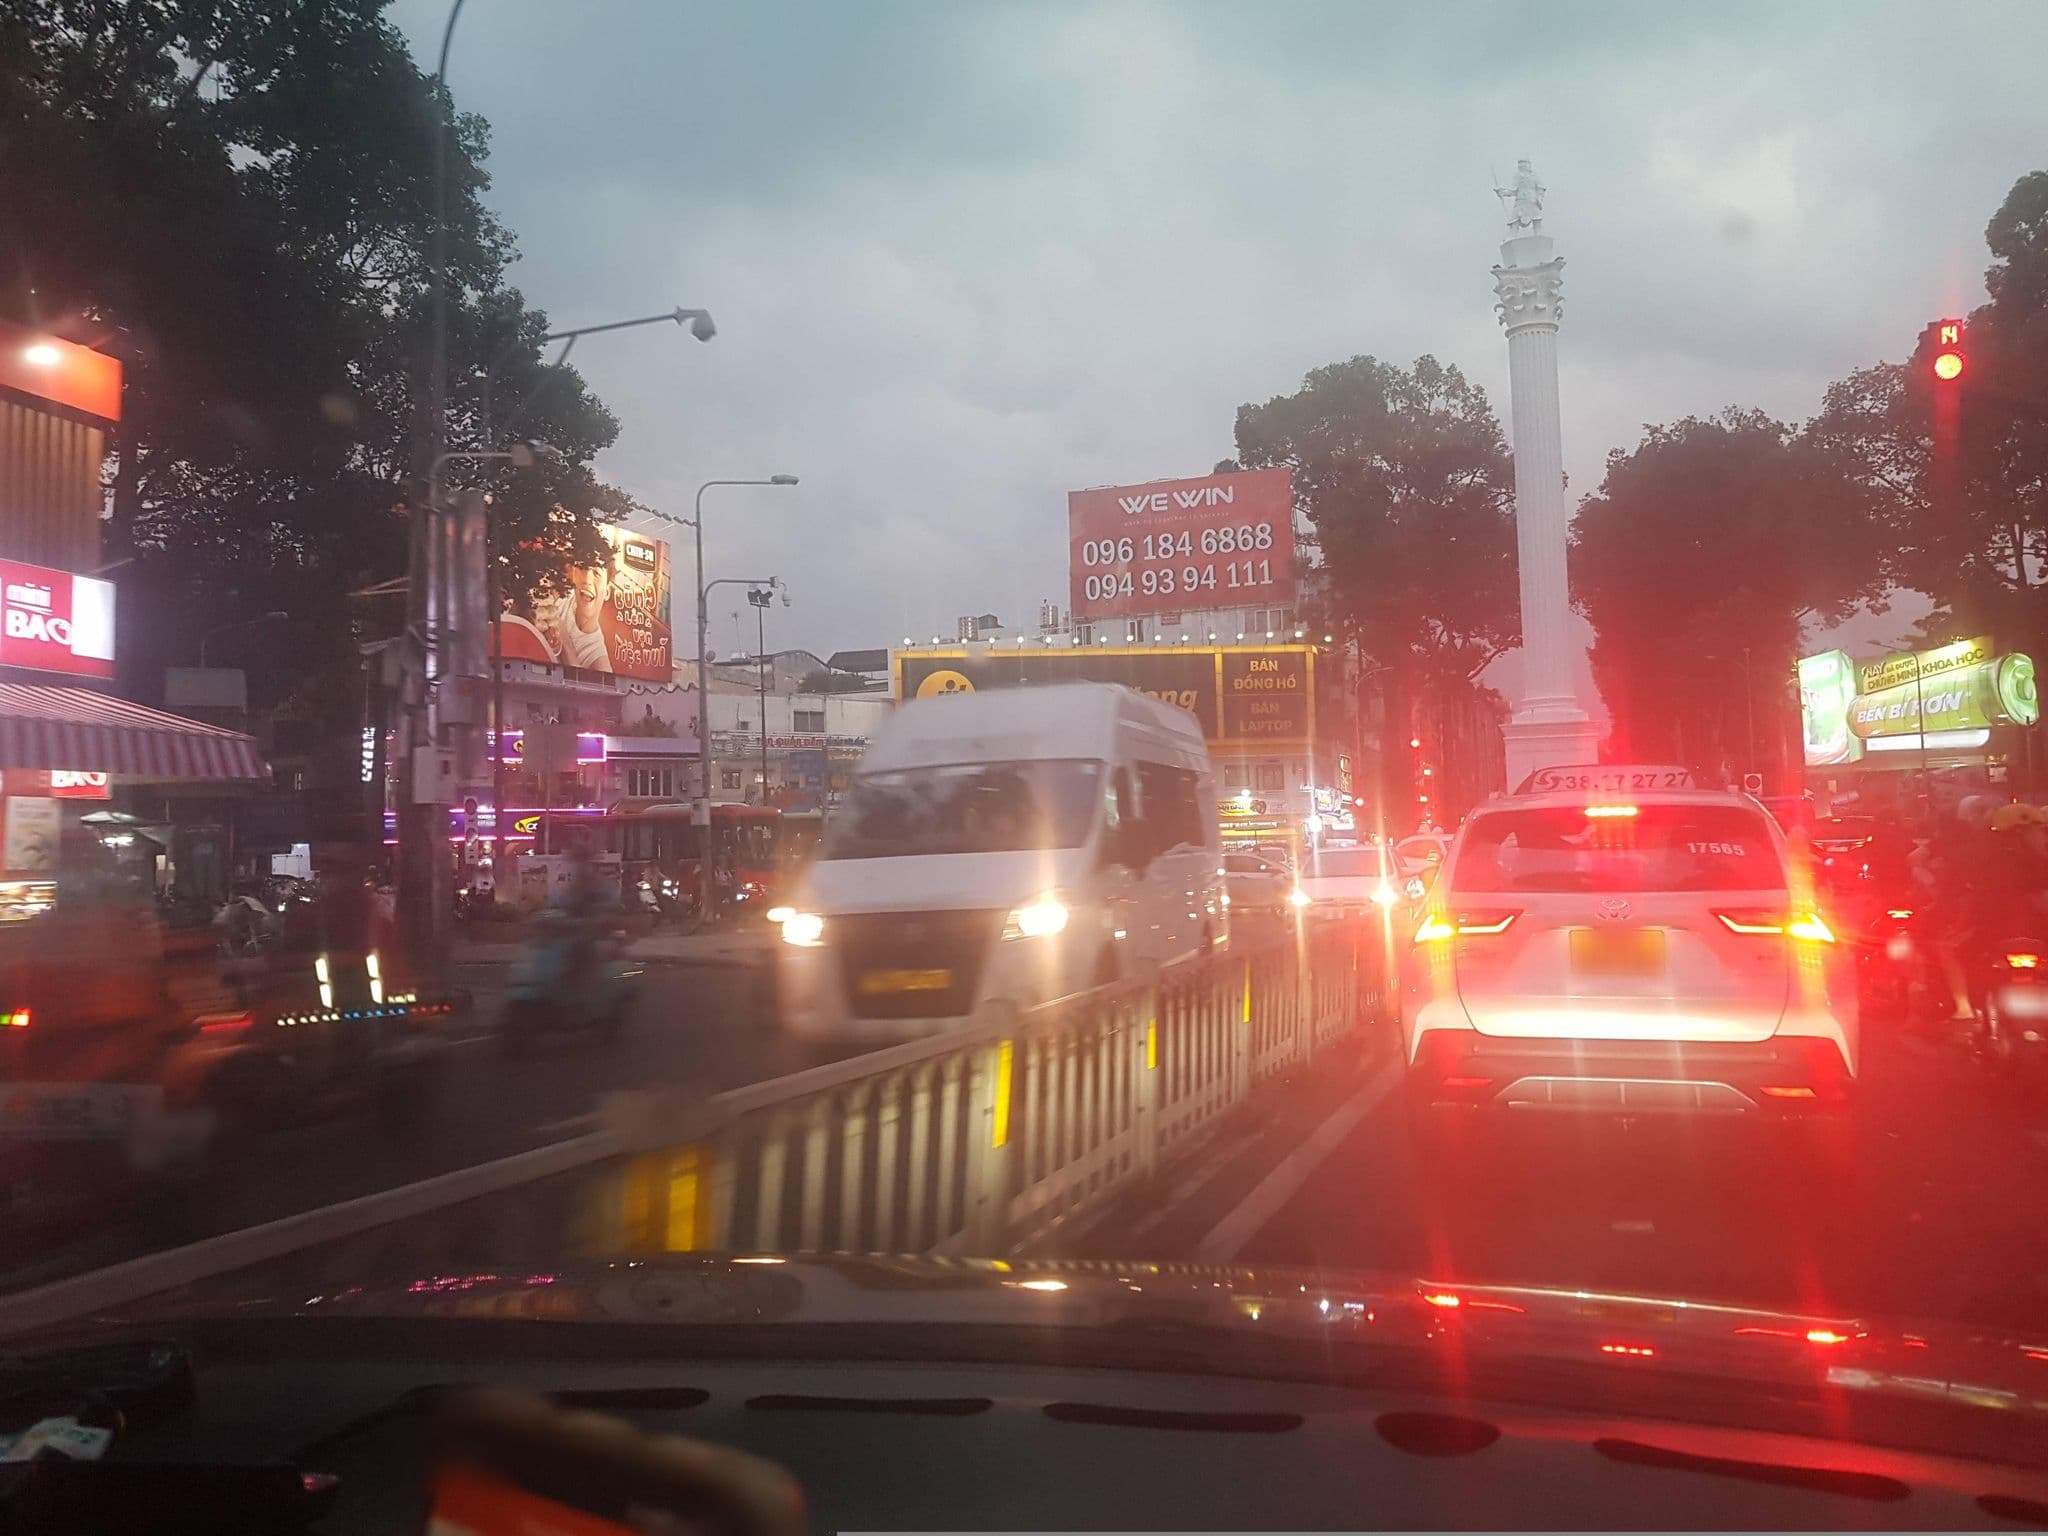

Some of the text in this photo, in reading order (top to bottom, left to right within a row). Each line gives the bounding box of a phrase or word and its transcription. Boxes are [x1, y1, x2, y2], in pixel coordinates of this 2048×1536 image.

[1940, 325, 1959, 345] 14
[1118, 485, 1235, 514] WE WIN
[1082, 522, 1273, 567] 096 184 6868
[1085, 559, 1273, 601] 094 93 94 111
[1249, 657, 1279, 672] BÁN
[1896, 666, 1920, 682] MINH
[1921, 658, 1954, 676] KHOA
[1955, 647, 1985, 666] HỌC
[1239, 719, 1293, 733] LAPTOP
[1632, 774, 1657, 788] 27
[1664, 772, 1689, 787] 27
[1687, 842, 1745, 857] 17565
